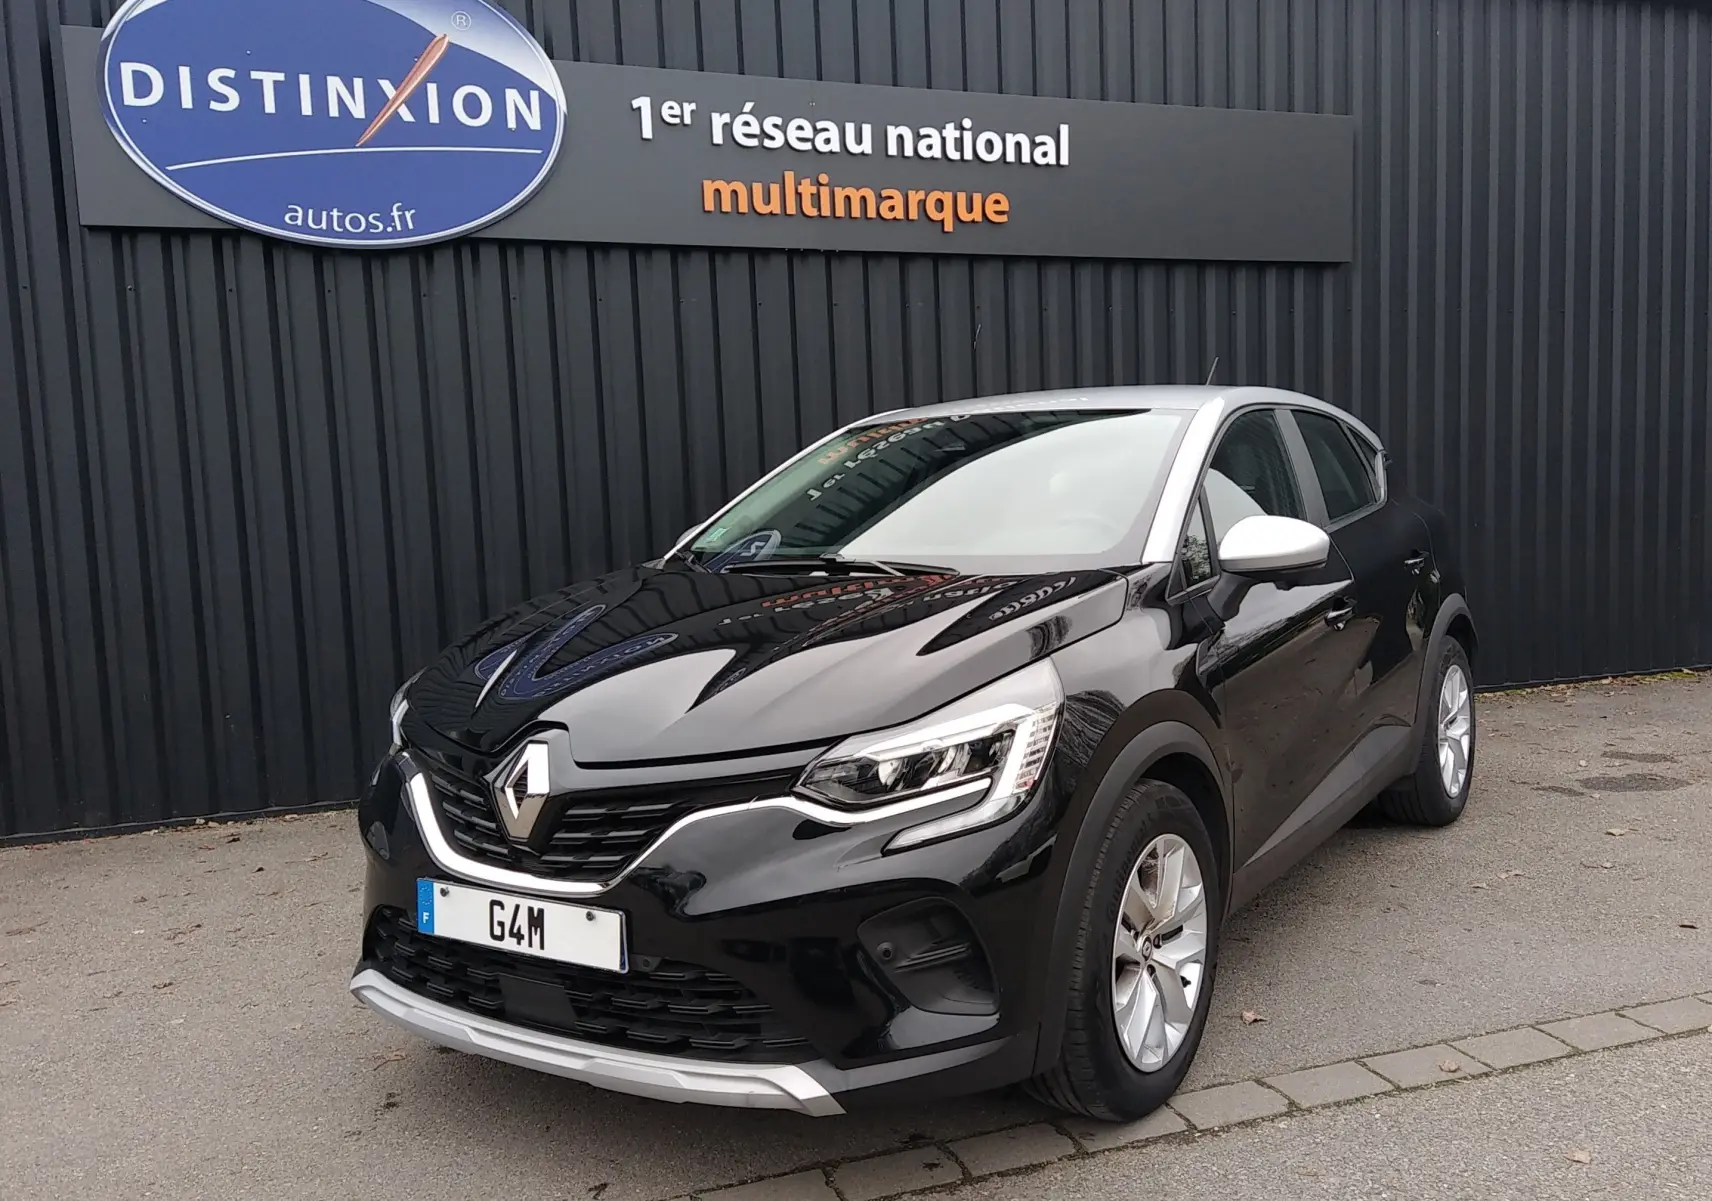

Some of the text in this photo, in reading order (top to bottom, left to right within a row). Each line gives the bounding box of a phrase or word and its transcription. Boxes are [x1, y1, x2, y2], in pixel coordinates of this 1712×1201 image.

[119, 61, 542, 132] DISTINXION
[632, 95, 1070, 166] 1er réseau national
[283, 202, 416, 235] autos.fr
[702, 171, 1011, 233] multimarque
[422, 899, 545, 951] F G4M
